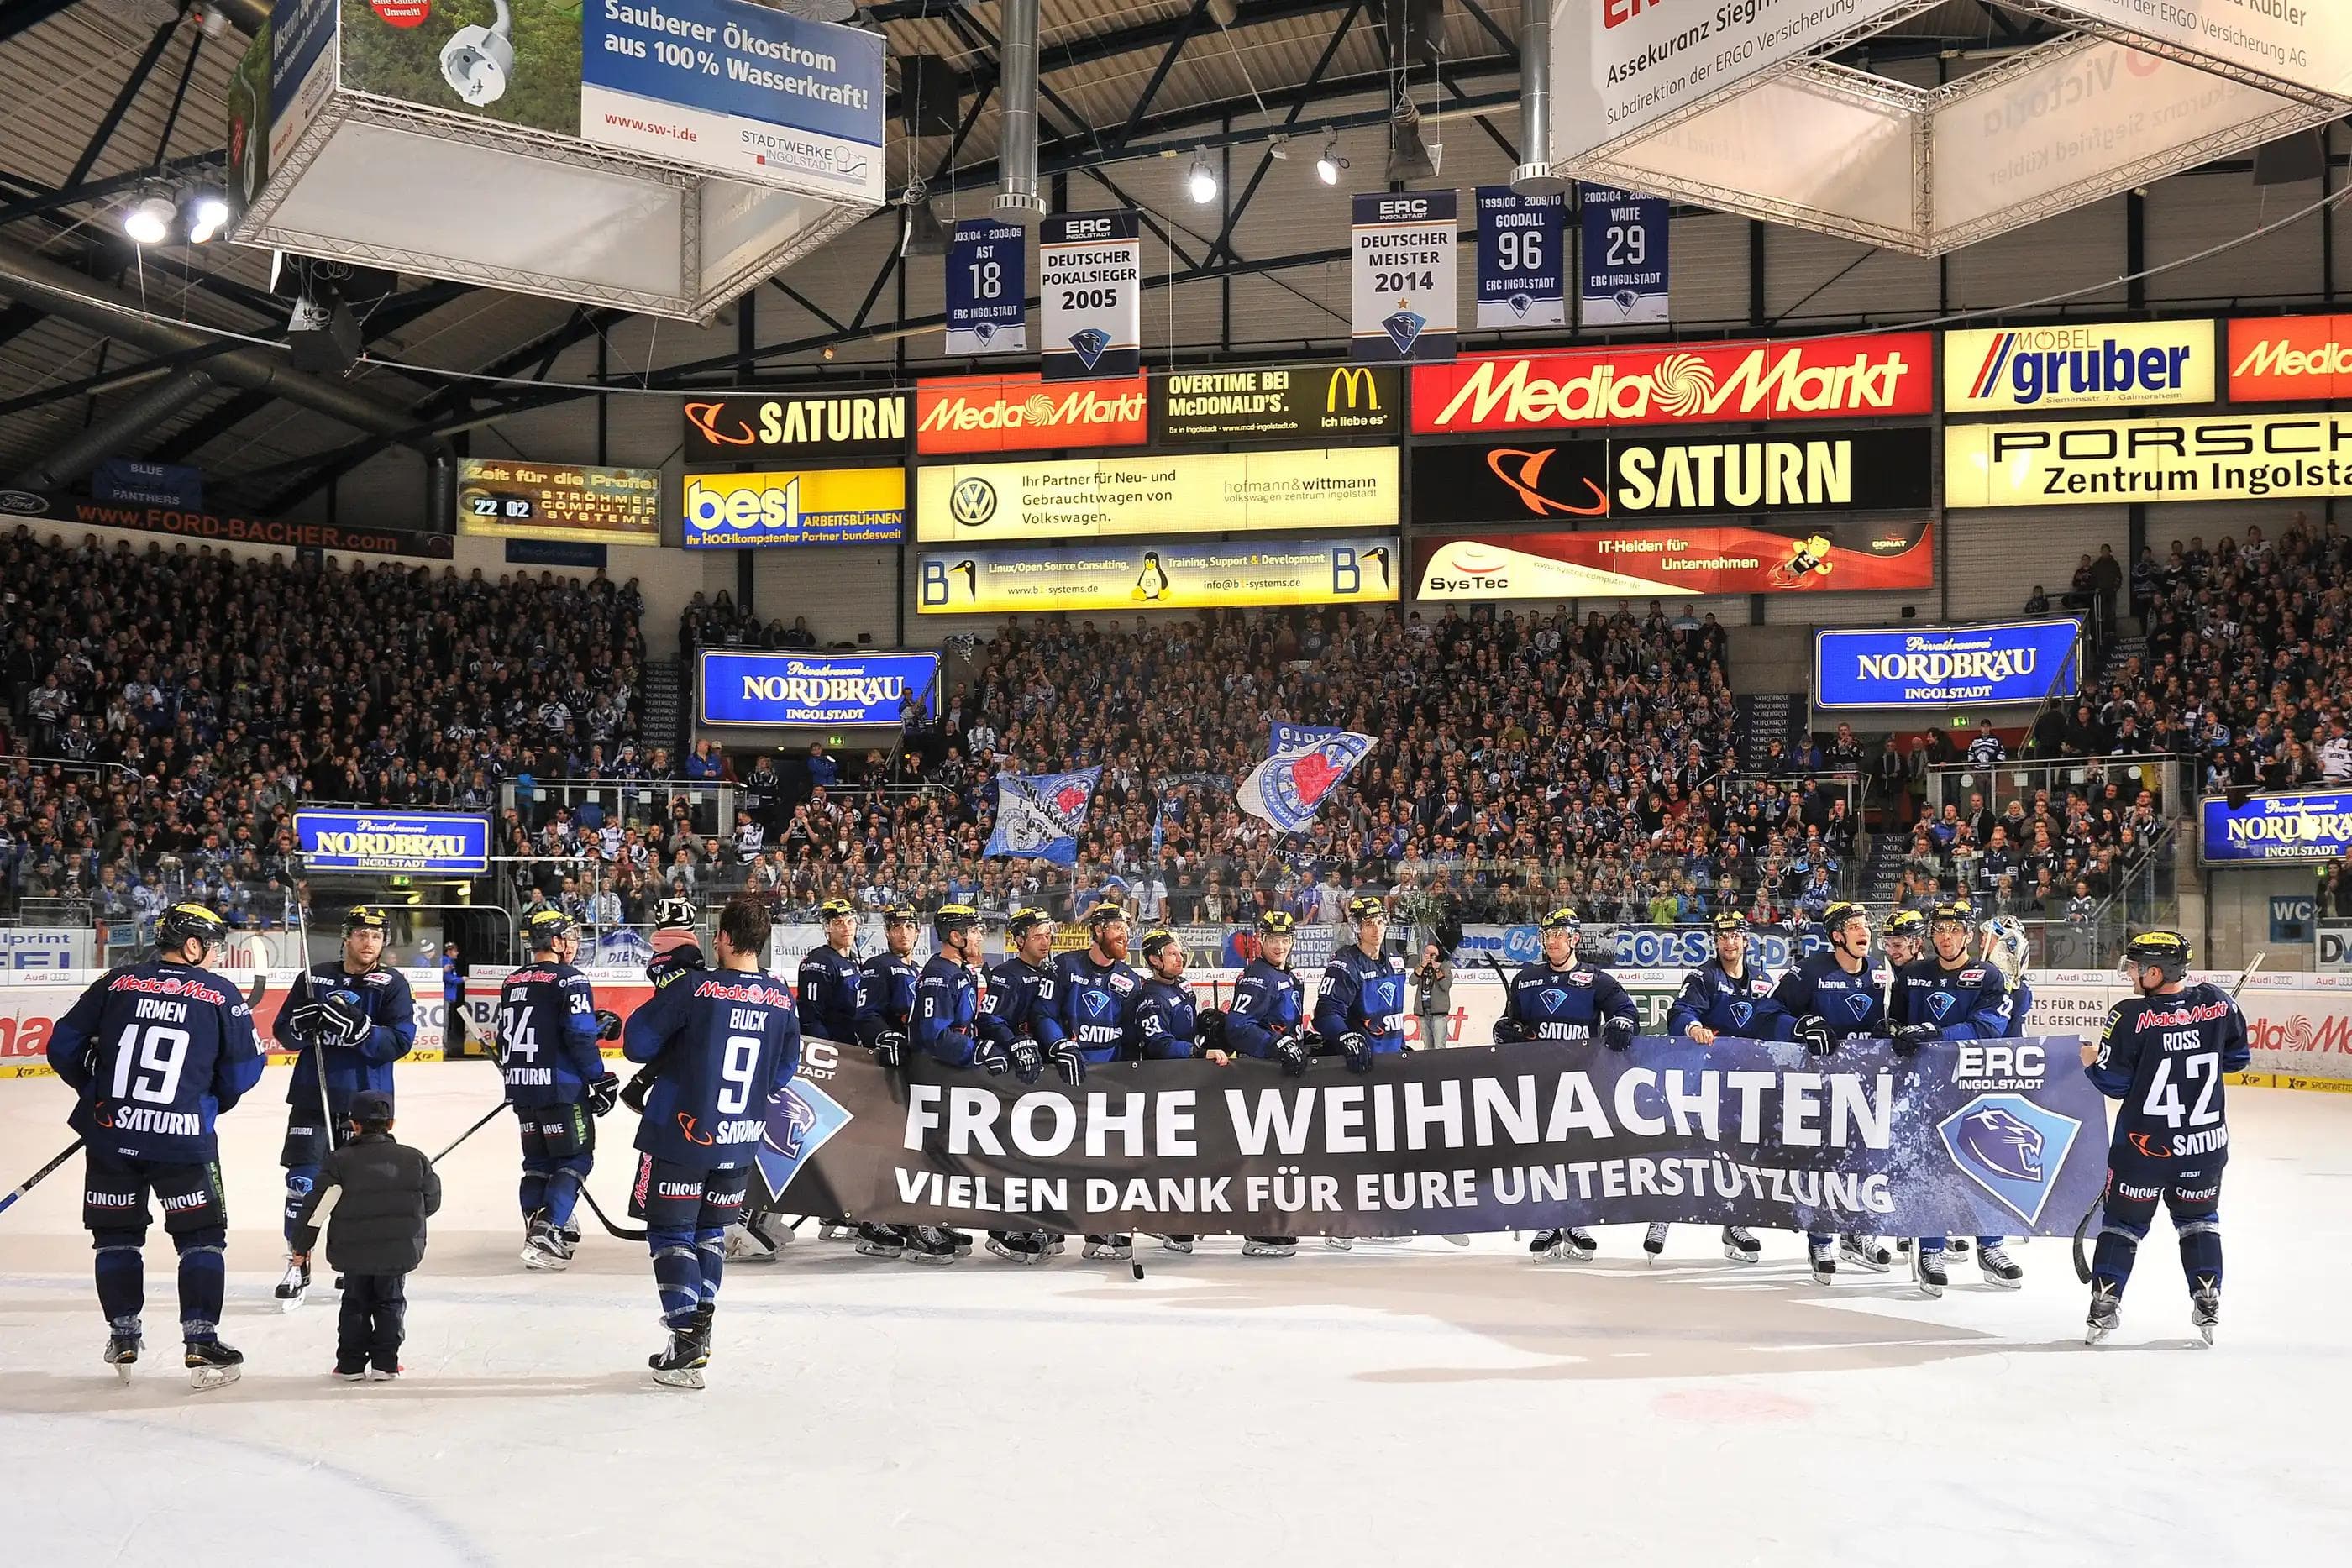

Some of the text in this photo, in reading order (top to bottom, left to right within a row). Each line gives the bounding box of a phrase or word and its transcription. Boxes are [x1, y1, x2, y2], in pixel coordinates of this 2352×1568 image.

[383, 7, 421, 18] Umwelt!
[605, 0, 837, 74] Sauberer Ökostrom
[2161, 2, 2197, 29] ERGO
[2201, 16, 2286, 66] Versicherung
[2289, 48, 2307, 68] AG
[1606, 21, 1709, 88] Assekuranz
[1607, 0, 1856, 125] Subdirektion der ERGO Versicherung
[603, 33, 647, 59] aus
[725, 56, 869, 111] Wasserkraft!
[604, 113, 698, 143] www.sw-i.de
[741, 130, 833, 160] STADTWERKE
[765, 149, 834, 173] INGOLSTADT
[1379, 199, 1428, 214] ERC
[1610, 207, 1641, 223] WAITE
[1378, 212, 1427, 221] INGOLSTADT
[1495, 212, 1546, 228] GOODALL
[1065, 218, 1111, 234] ERC
[1360, 232, 1448, 249] DEUTSCHER
[1605, 224, 1646, 267] 29
[976, 245, 995, 259] AST
[1047, 250, 1131, 268] DEUTSCHER
[1368, 250, 1441, 267] MEISTER
[1497, 230, 1543, 271] 96
[969, 261, 1002, 299] 18
[1042, 268, 1137, 286] POKALSIEGER
[1374, 270, 1434, 293] 2014
[1485, 276, 1555, 291] ERC INGOLSTADT
[1590, 271, 1662, 287] ERC INGOLSTADT
[1061, 288, 1117, 311] 2005
[953, 305, 1017, 320] ERC INGOLSTADT
[2014, 329, 2097, 351] MÖBEL
[2011, 339, 2191, 405] gruber
[1168, 370, 1289, 395] OVERTIME BEI
[1433, 347, 1909, 426] Media Markt
[2104, 394, 2111, 402] 7
[2118, 391, 2183, 401] Gaimersheim
[759, 396, 906, 445] SATURN
[917, 390, 1147, 433] Media Markt
[1340, 415, 1368, 427] liebe
[129, 463, 165, 476] BLUE
[465, 466, 659, 490] Zeit für die Profis!
[1022, 469, 1177, 487] Ihr Partner für Neu- und
[1618, 439, 1851, 511] SATURN
[1224, 477, 1377, 493] hofmann&wittmann
[2043, 465, 2198, 495] Zentrum
[112, 488, 181, 506] PANTHERS
[540, 490, 656, 506] STRÖHMER
[686, 475, 800, 531] besl
[1022, 491, 1173, 506] Gebrauchtwagen von
[1224, 489, 1378, 504] volkswagen zentrum ingolstadt
[474, 499, 530, 518] 22 02
[540, 501, 657, 516] COMPUTER
[546, 511, 652, 525] SYSTEME
[802, 511, 903, 527] ARBEITSBÜHNEN
[1021, 511, 1112, 526] Volkswagen.
[76, 503, 399, 553] www.FORD-BACHER.com
[686, 529, 902, 546] Ihr HOCHkompetenter Partner bundesweit
[1599, 538, 1690, 554] IT-Helden für
[988, 559, 1130, 574] Linux/Open Source Consulting,
[1209, 555, 1248, 568] Support
[1250, 554, 1259, 565] &
[1261, 553, 1326, 567] Development
[1661, 556, 1760, 572] Unternehmen
[1430, 576, 1509, 592] SysTec
[1856, 648, 2037, 685] NORDBRÄU
[742, 675, 905, 707] NORDBRÄU
[1904, 684, 1993, 700] INGOLSTADT
[785, 708, 866, 721] INGOLSTADT
[315, 831, 467, 859] NORDBRÄU
[2265, 844, 2339, 857] INGOLSTADT
[357, 857, 428, 868] INGOLSTADT
[2273, 901, 2312, 921] WC
[1509, 930, 1539, 955] 64
[1205, 972, 1228, 980] Audi
[2055, 973, 2080, 982] Audi
[2316, 977, 2337, 986] Audi
[807, 982, 818, 1001] 11
[1318, 976, 1336, 996] 81
[135, 998, 188, 1024] IRMEN
[569, 994, 592, 1015] 34
[924, 996, 934, 1018] 8
[1233, 993, 1252, 1015] 12
[2053, 997, 2103, 1011] FÜR DAS
[729, 1008, 769, 1032] BUCK
[1141, 1014, 1163, 1037] 33
[2162, 1029, 2202, 1051] ROSS
[112, 1023, 191, 1104] 19
[1958, 1046, 2046, 1078] ERC
[716, 1036, 762, 1114] 9
[1958, 1078, 2045, 1092] INGOLSTADT
[2142, 1051, 2220, 1129] 42
[114, 1105, 201, 1136] SATURN
[902, 1066, 1893, 1159] FROHE WEIHNACHTEN
[658, 1181, 703, 1197] CINQUE
[894, 1150, 1897, 1215] VIELEN DANK FÜR EURE UNTERSTÜTZUNG
[2118, 1181, 2160, 1199] CINQUE
[86, 1190, 137, 1207] CINQUE
[706, 1188, 747, 1206] CINQUE
[2176, 1185, 2218, 1199] CINQUE
